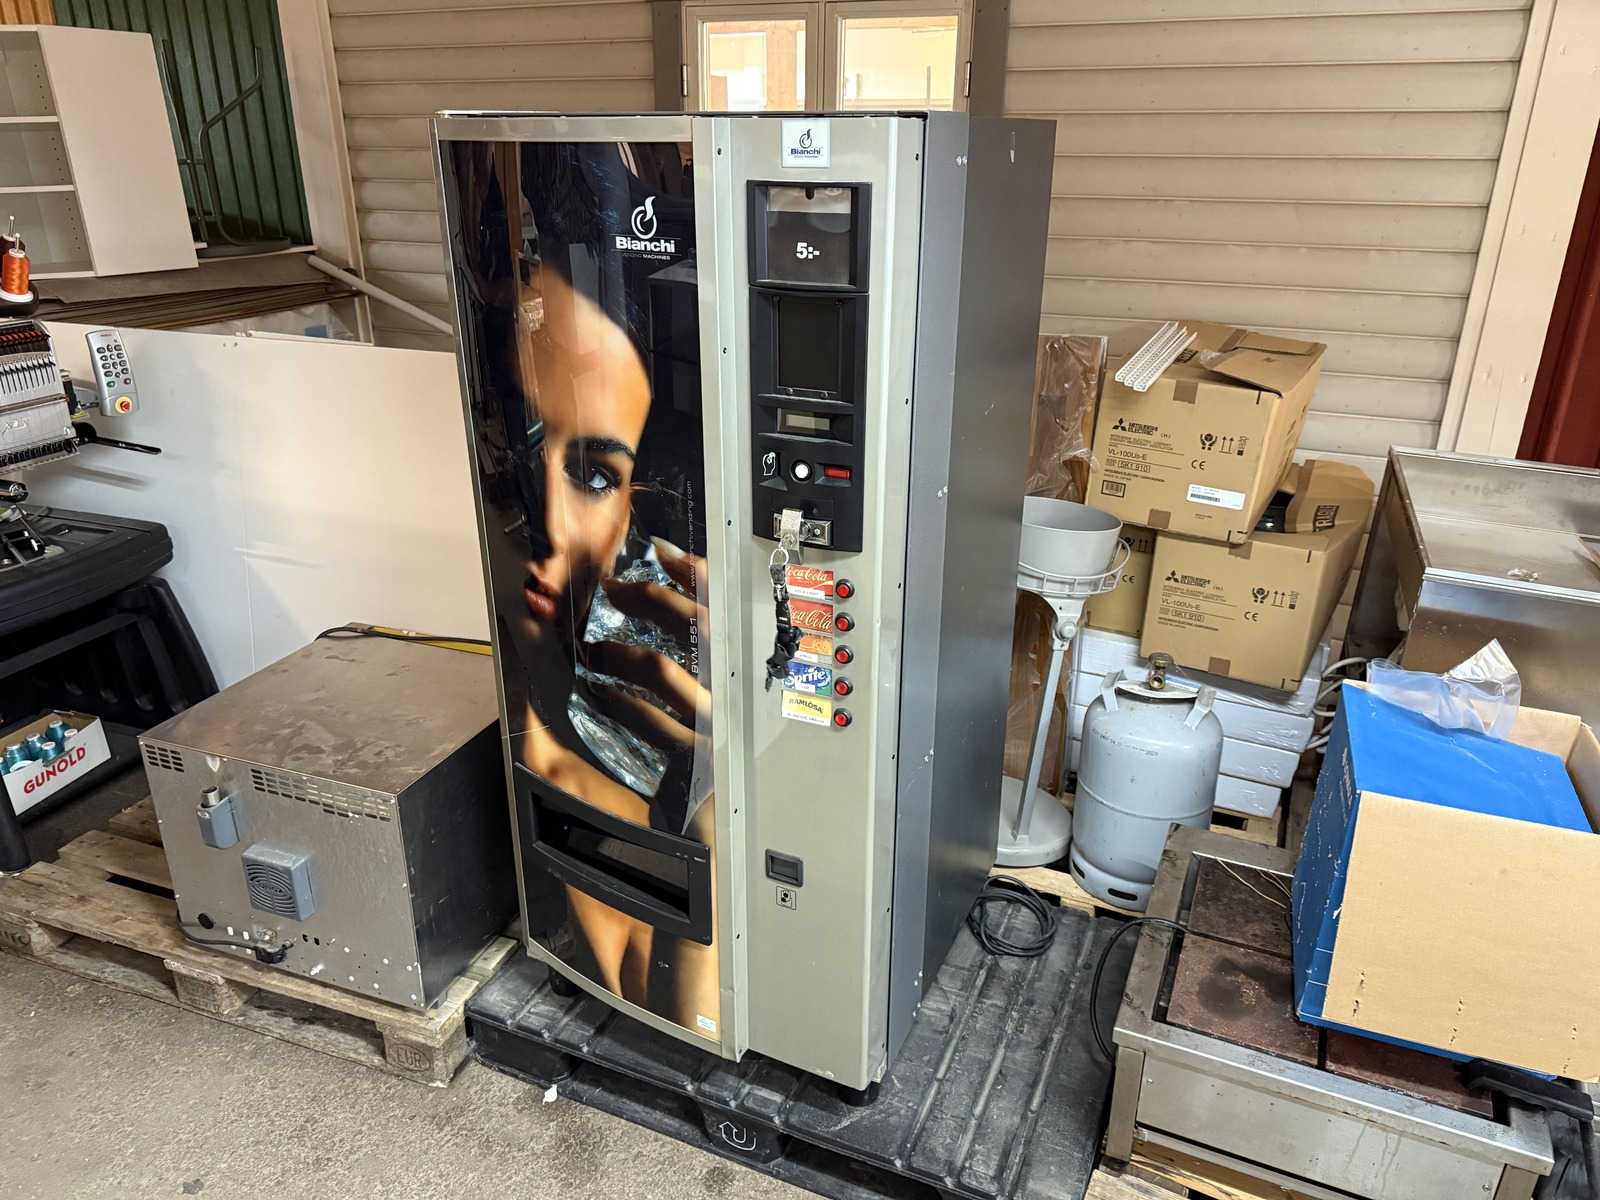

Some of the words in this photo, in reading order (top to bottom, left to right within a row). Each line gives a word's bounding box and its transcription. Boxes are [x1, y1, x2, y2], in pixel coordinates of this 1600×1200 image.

[615, 236, 675, 253] Bianchi
[1128, 422, 1158, 431] MITSUBISHI
[1180, 579, 1206, 588] ELECTRIC
[1181, 575, 1211, 584] MITSUBISHI
[689, 617, 698, 646] 551
[785, 668, 825, 685] Sprite
[789, 699, 823, 714] RAMLÖSA
[24, 746, 86, 794] GUNOLD
[397, 1047, 422, 1070] EUR
